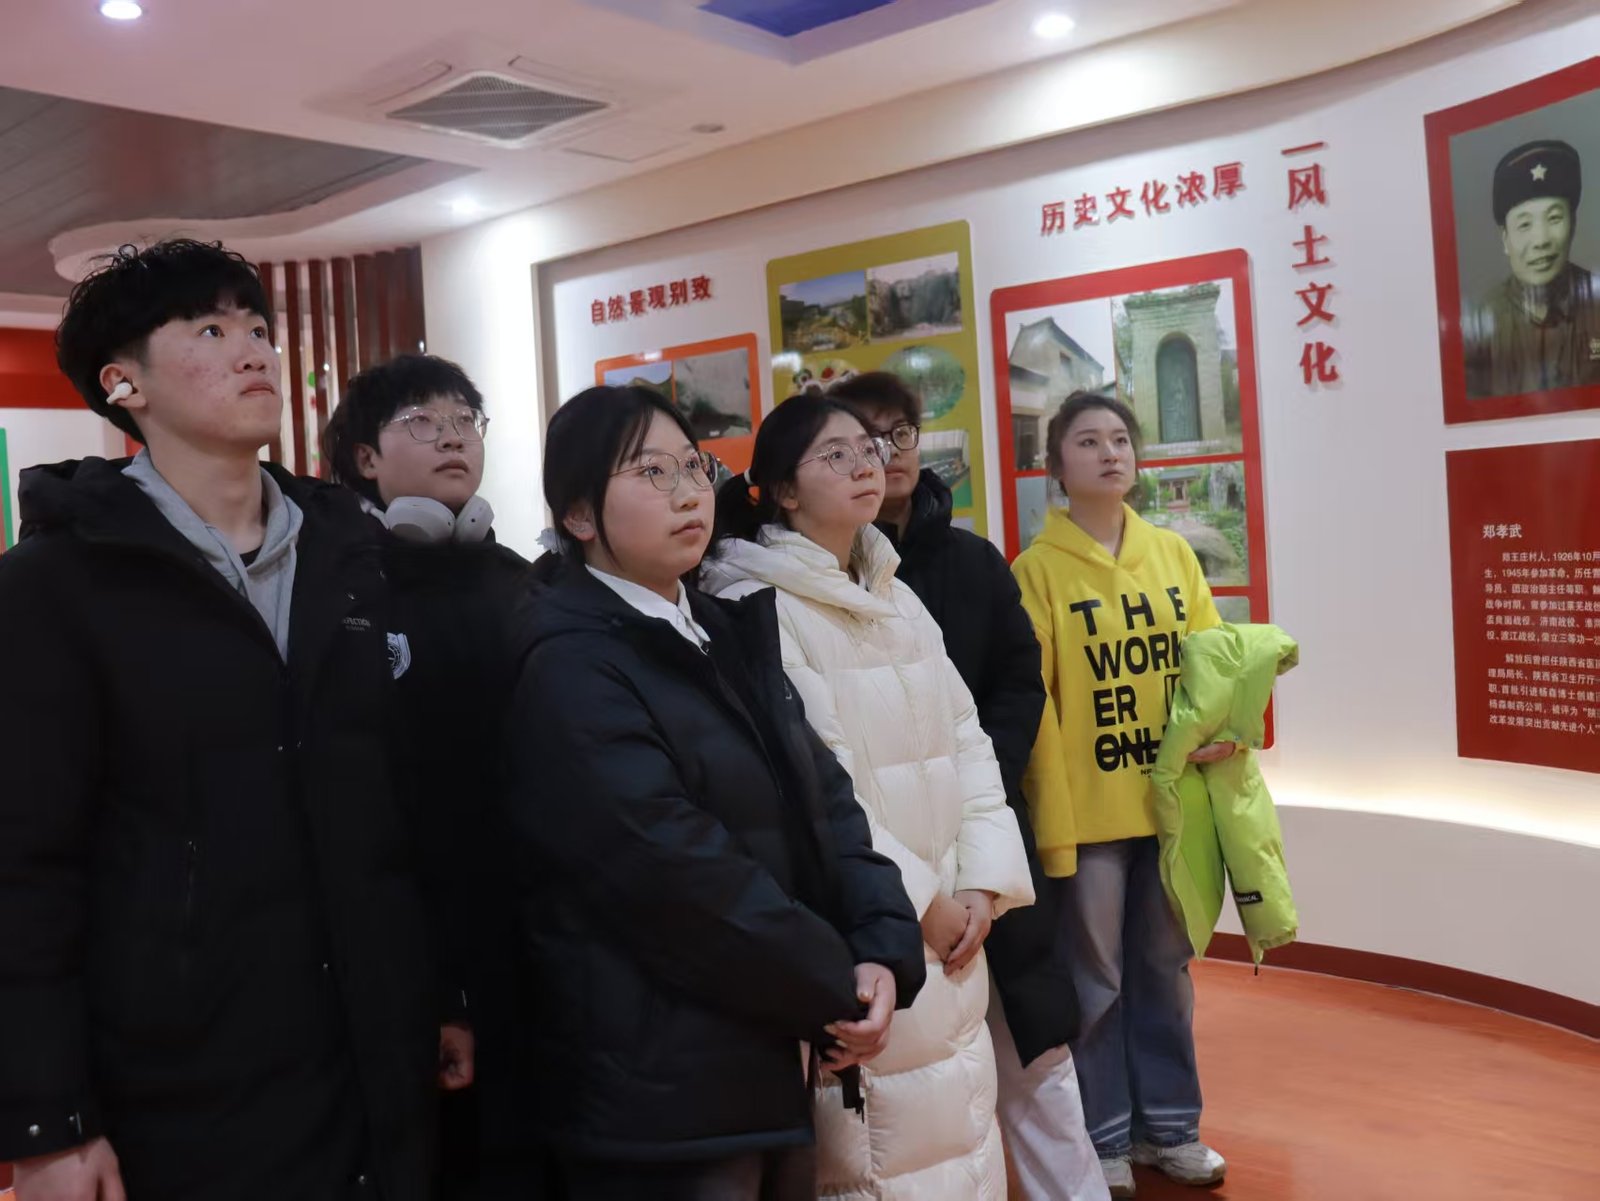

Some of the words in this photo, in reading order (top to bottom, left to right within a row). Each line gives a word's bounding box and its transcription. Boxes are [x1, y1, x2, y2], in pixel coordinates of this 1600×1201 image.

[1040, 161, 1246, 236] 历史文化浓厚
[590, 274, 712, 326] 自然景观别致
[1483, 524, 1523, 539] 郑孝武
[1069, 586, 1187, 637] THE
[1093, 685, 1138, 727] ER
[1095, 724, 1167, 772] ONL
